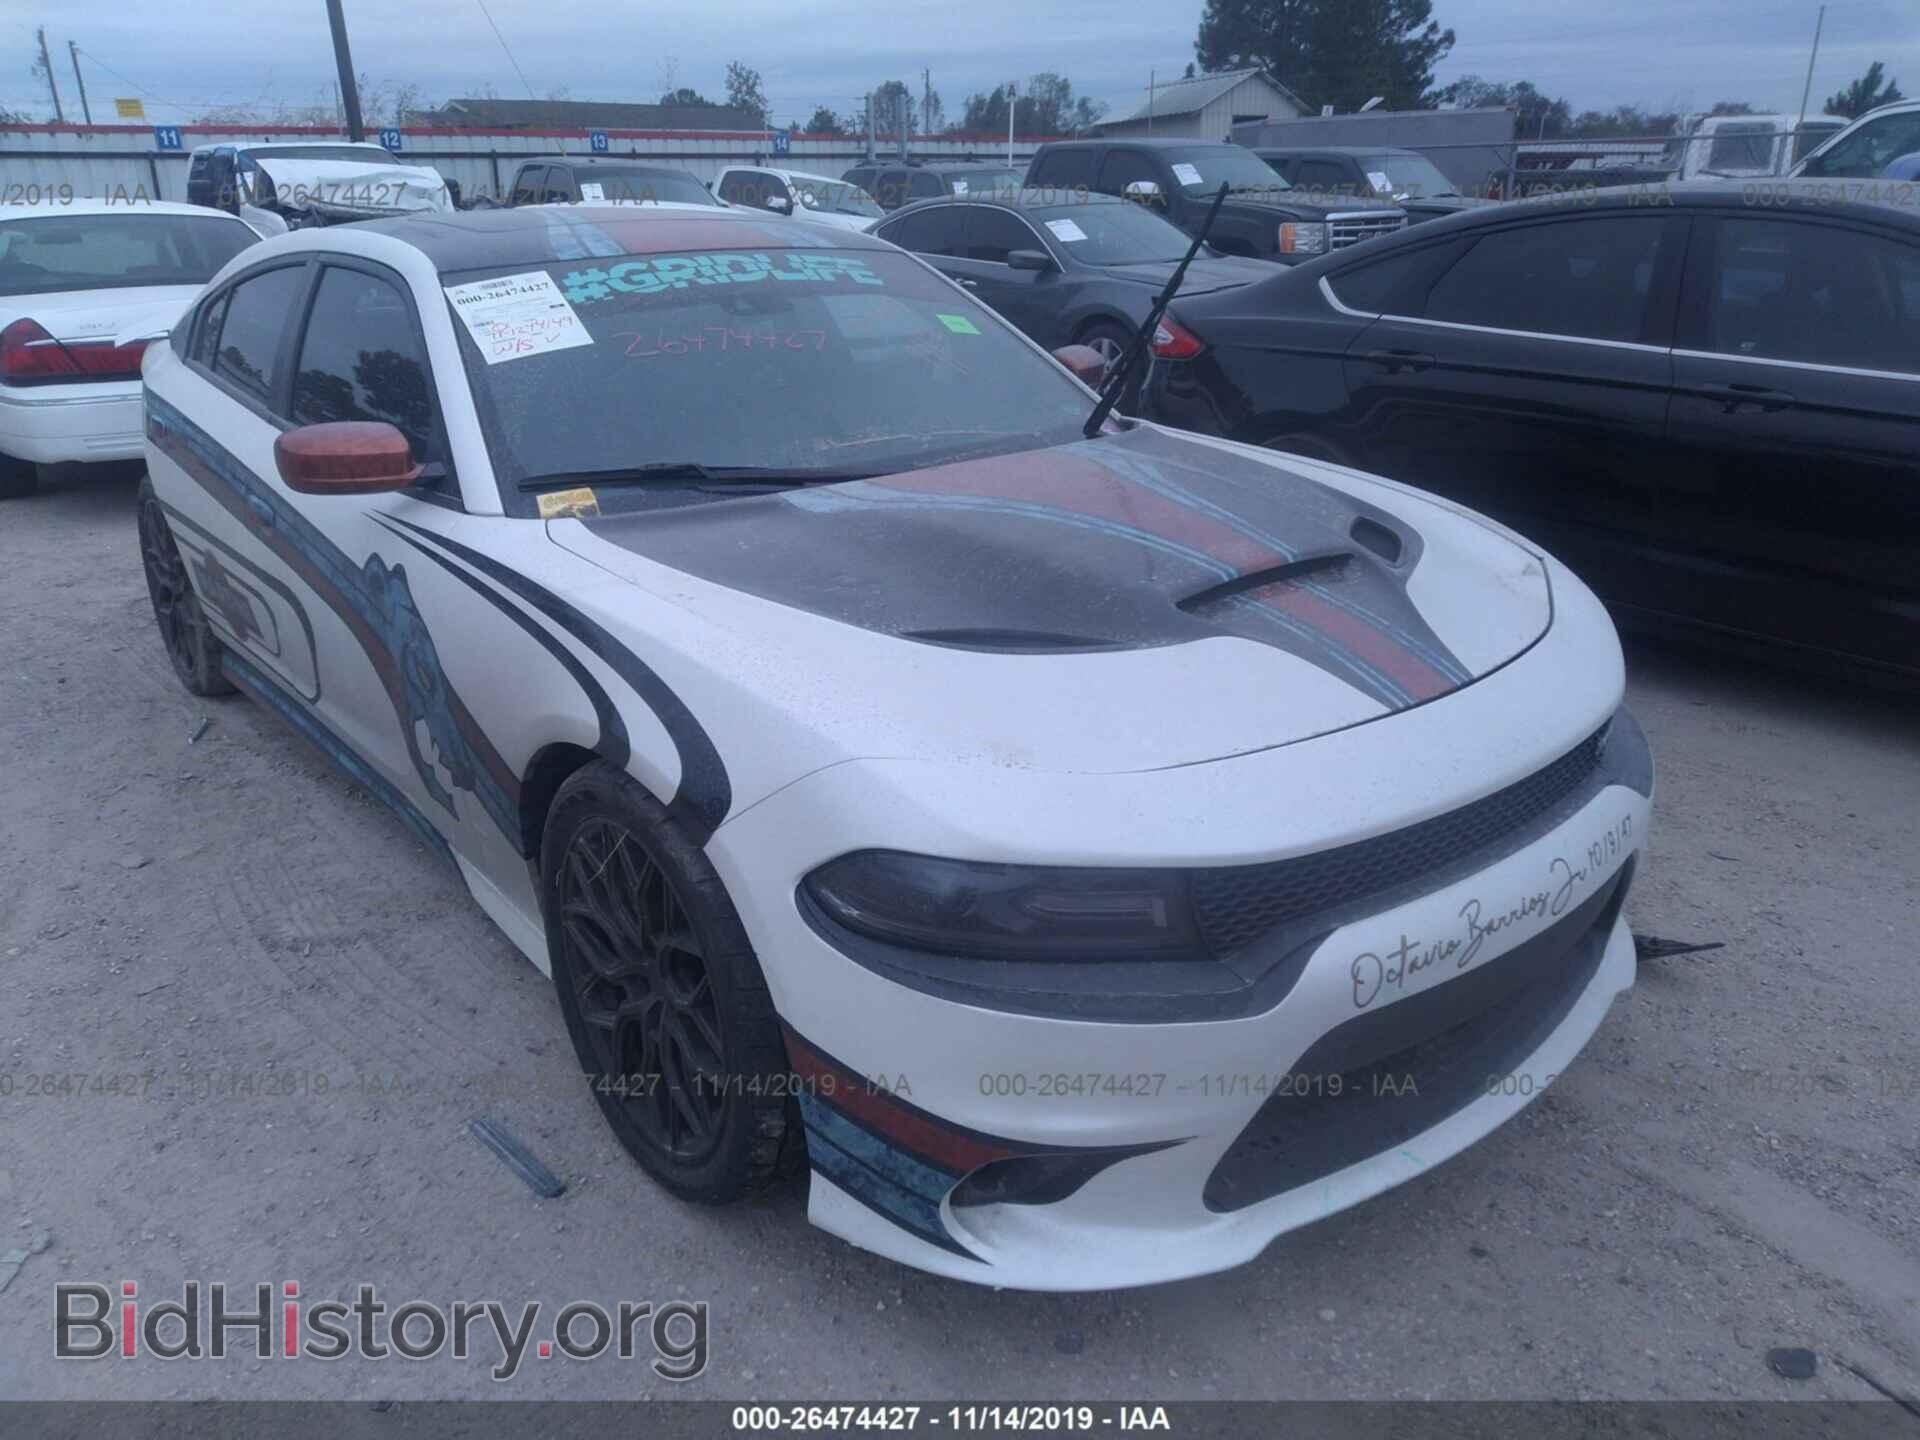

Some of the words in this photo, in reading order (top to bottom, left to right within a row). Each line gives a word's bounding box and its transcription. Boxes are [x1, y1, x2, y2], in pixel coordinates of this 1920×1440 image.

[160, 131, 178, 146] 11
[381, 131, 399, 147] 12
[592, 132, 606, 149] 13
[775, 137, 787, 150] 14
[565, 253, 884, 304] #GRIDLIFE
